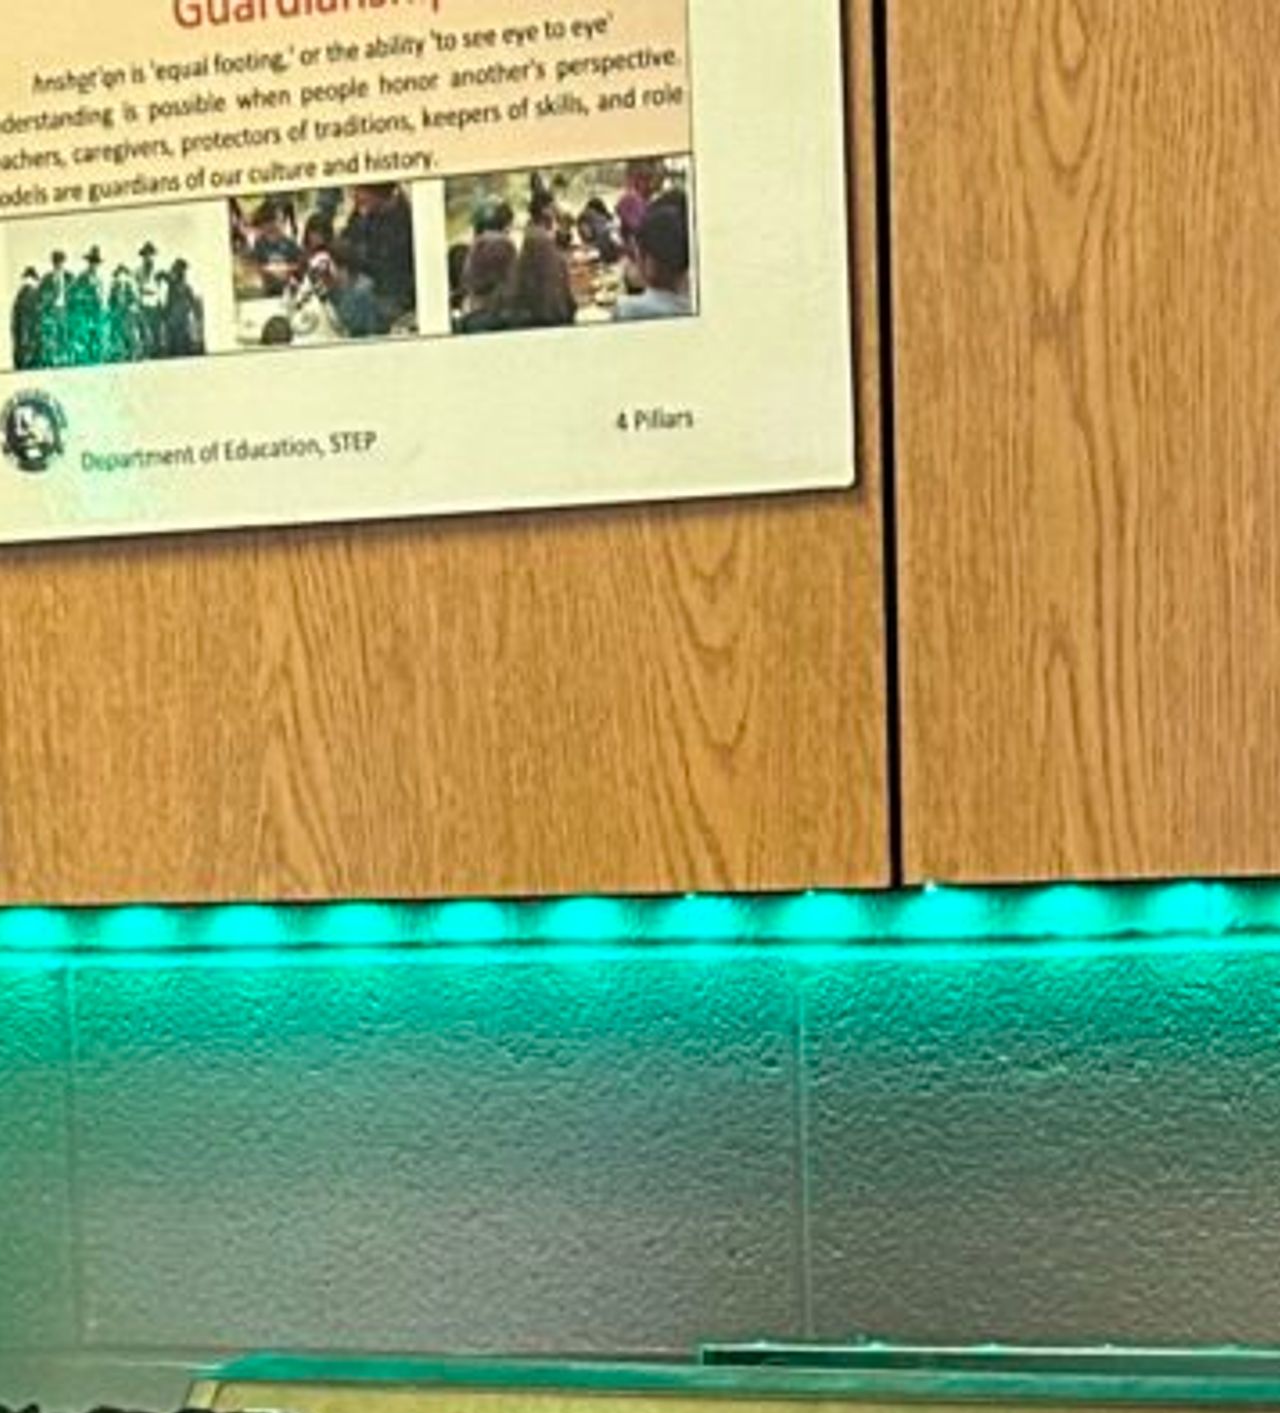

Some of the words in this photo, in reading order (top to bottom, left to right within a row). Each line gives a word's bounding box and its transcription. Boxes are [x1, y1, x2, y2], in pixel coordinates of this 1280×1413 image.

[131, 65, 145, 84] is
[151, 59, 208, 82] 'equal
[300, 48, 321, 66] or
[326, 40, 360, 62] the
[365, 34, 424, 61] ability
[430, 29, 458, 51] 'to
[462, 29, 496, 48] see
[502, 24, 539, 46] eye
[544, 20, 566, 39] to
[570, 12, 613, 40] eye'
[124, 102, 138, 122] is
[149, 92, 226, 123] possible
[237, 88, 291, 110] when
[301, 77, 369, 107] people
[379, 73, 439, 95] honor
[451, 58, 546, 88] another's
[73, 140, 174, 165] caregivers,
[182, 127, 281, 157] protectors
[287, 118, 308, 142] of
[315, 112, 414, 140] traditions,
[422, 104, 501, 130] keepers
[508, 97, 528, 120] of
[535, 94, 590, 117] skills,
[598, 88, 636, 111] and
[643, 82, 683, 106] role
[53, 183, 83, 203] are
[89, 173, 180, 204] guardians
[186, 167, 204, 190] of
[210, 171, 243, 189] our
[248, 161, 317, 184] culture
[322, 154, 360, 177] and
[365, 151, 438, 172] history.
[616, 407, 628, 430] 4
[634, 406, 694, 431] Pillars
[81, 447, 195, 474] Department
[200, 441, 219, 464] of
[224, 438, 324, 463] Education,
[329, 431, 377, 455] STEP
